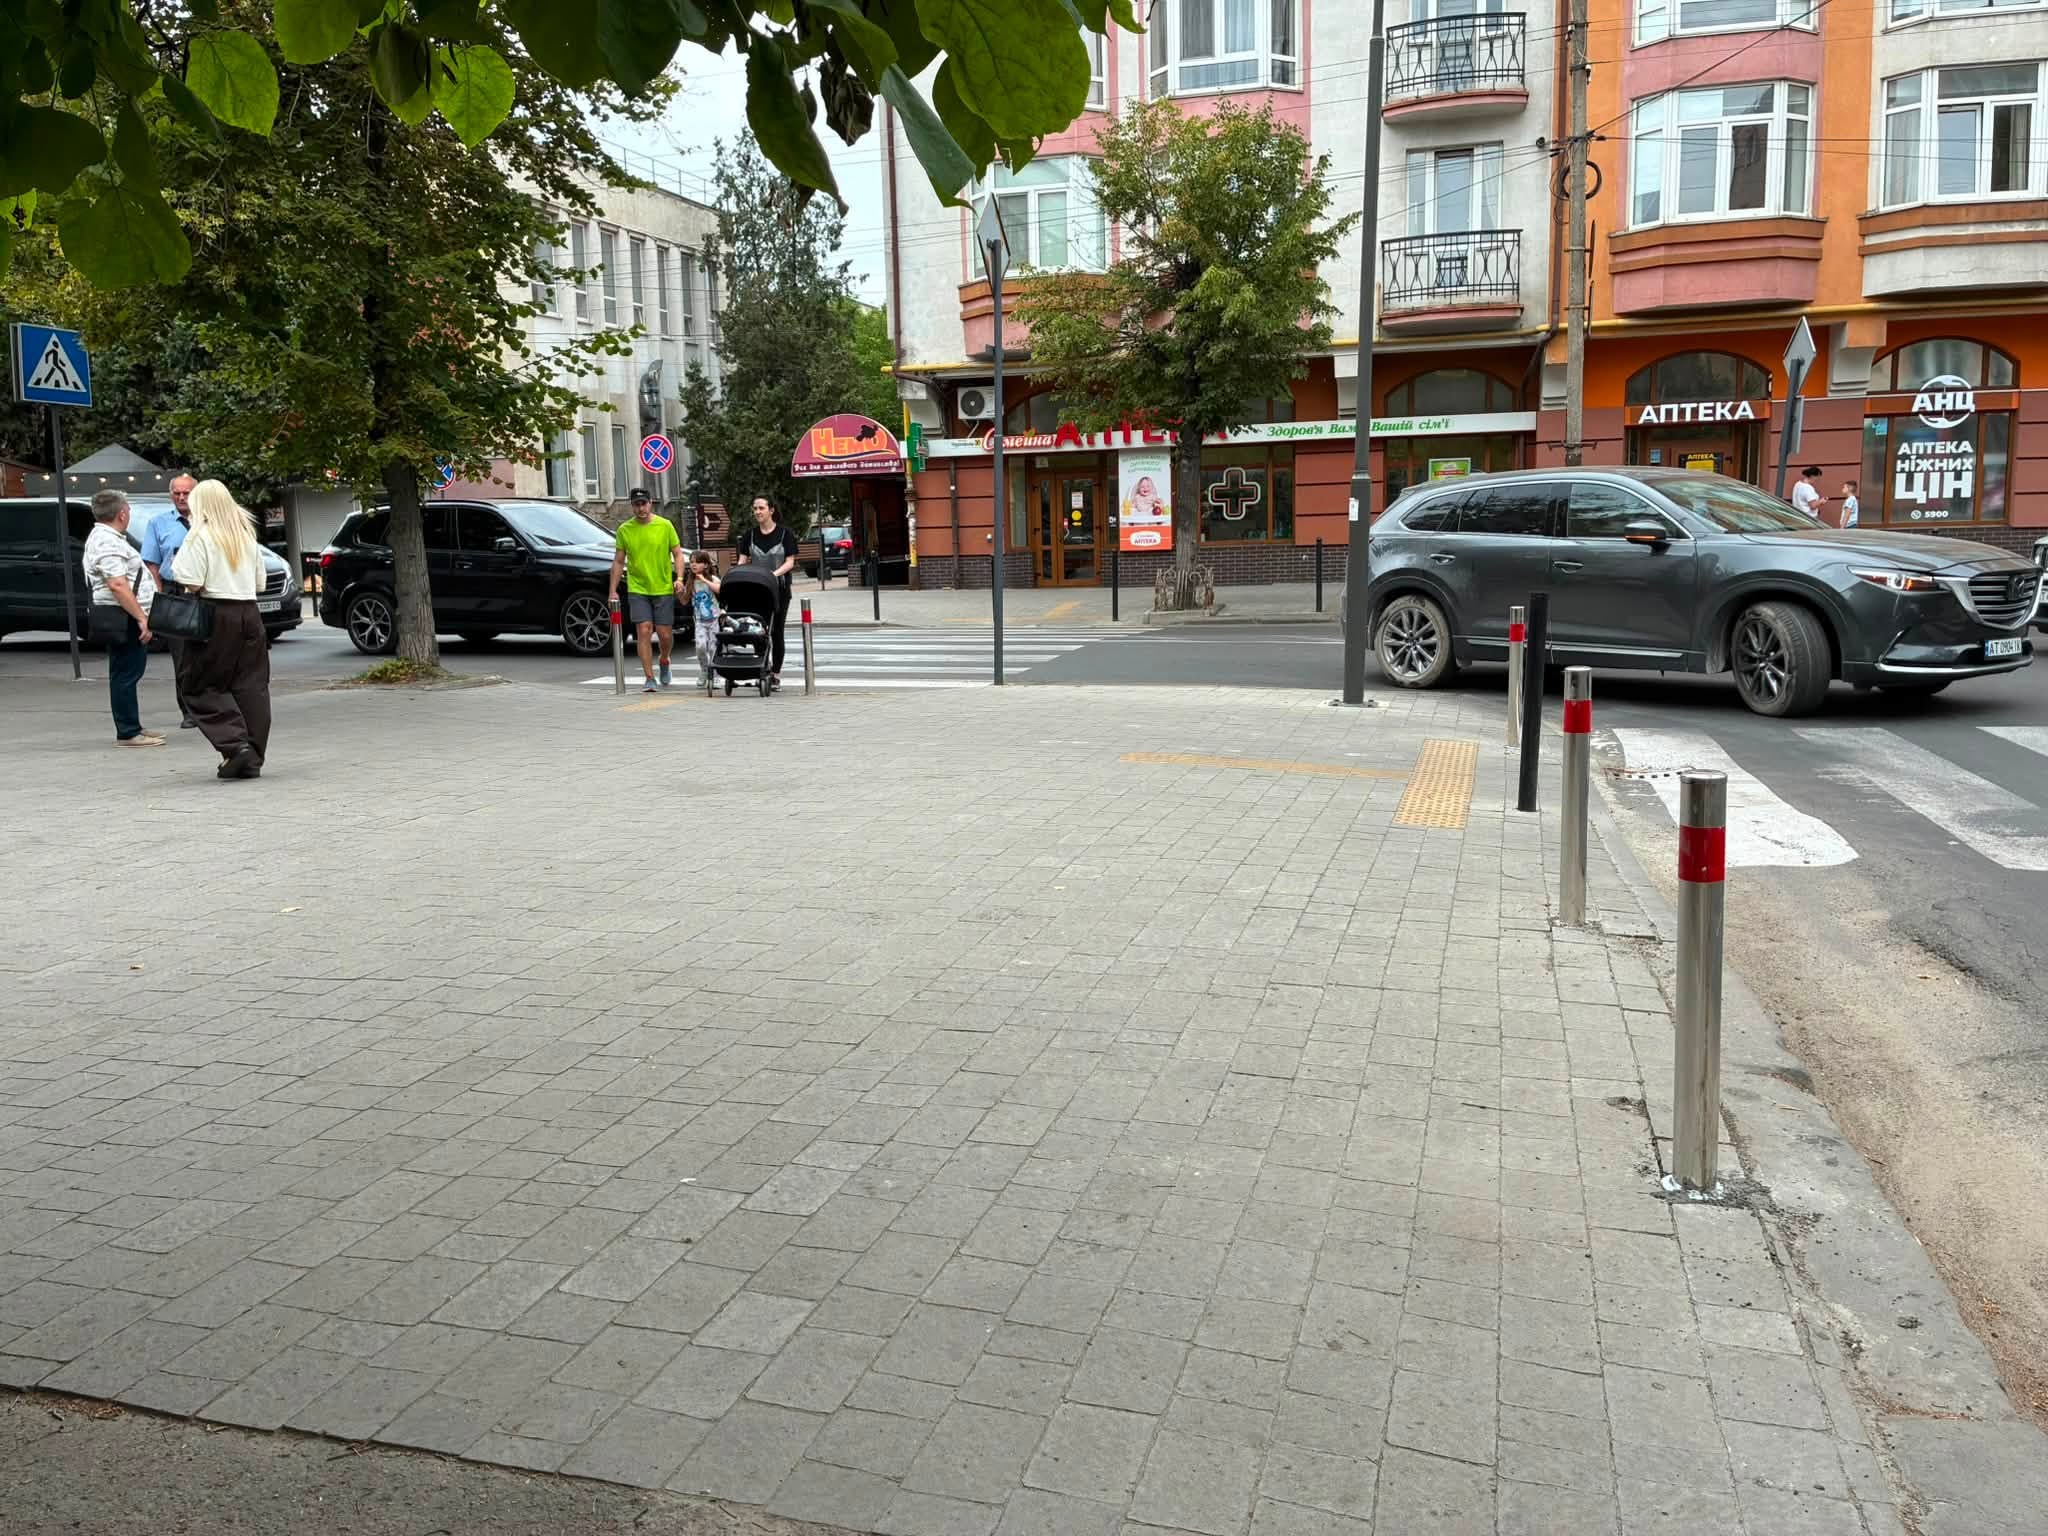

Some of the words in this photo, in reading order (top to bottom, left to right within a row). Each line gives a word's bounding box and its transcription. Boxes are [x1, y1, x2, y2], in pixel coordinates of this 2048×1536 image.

[1638, 400, 1755, 424] АПТЕКА
[1911, 391, 1975, 412] АНЦ
[1266, 424, 1323, 438] Здоров'я
[1327, 422, 1358, 434] Вам
[1371, 420, 1413, 432] Вашій
[1418, 417, 1450, 430] сім'ї
[1897, 440, 1974, 455] АПТЕКА
[1894, 471, 1973, 504] ЦІН
